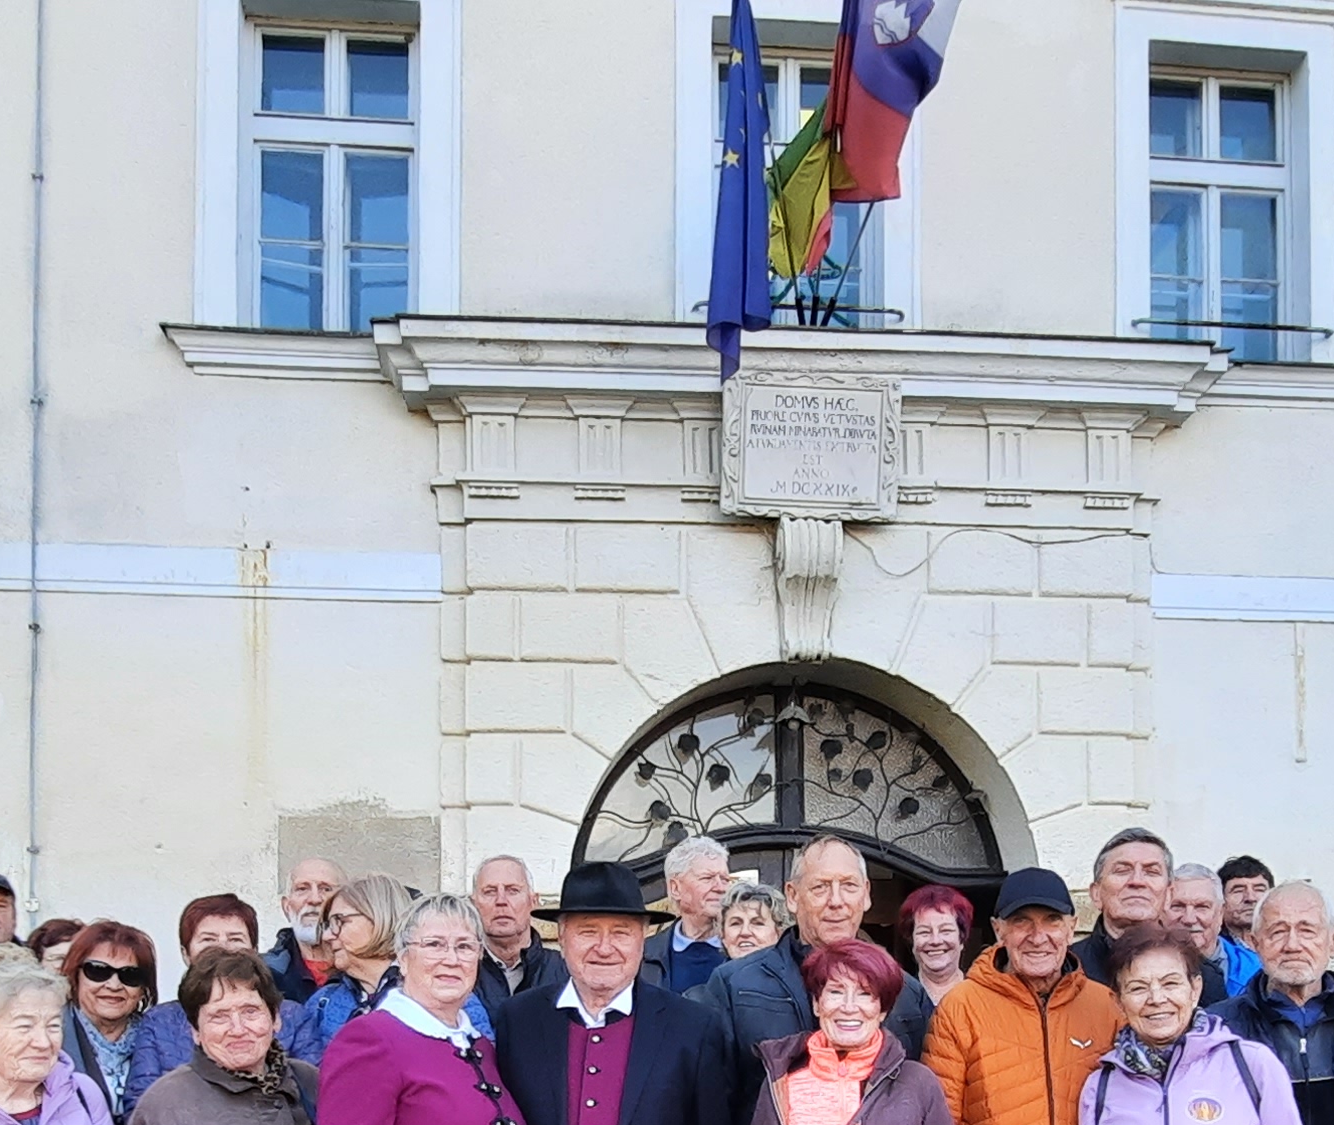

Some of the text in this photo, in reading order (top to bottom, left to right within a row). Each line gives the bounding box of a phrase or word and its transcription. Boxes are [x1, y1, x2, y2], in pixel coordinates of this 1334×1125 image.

[775, 394, 819, 409] DOMVS
[803, 453, 823, 465] EST
[793, 468, 830, 480] ANNO
